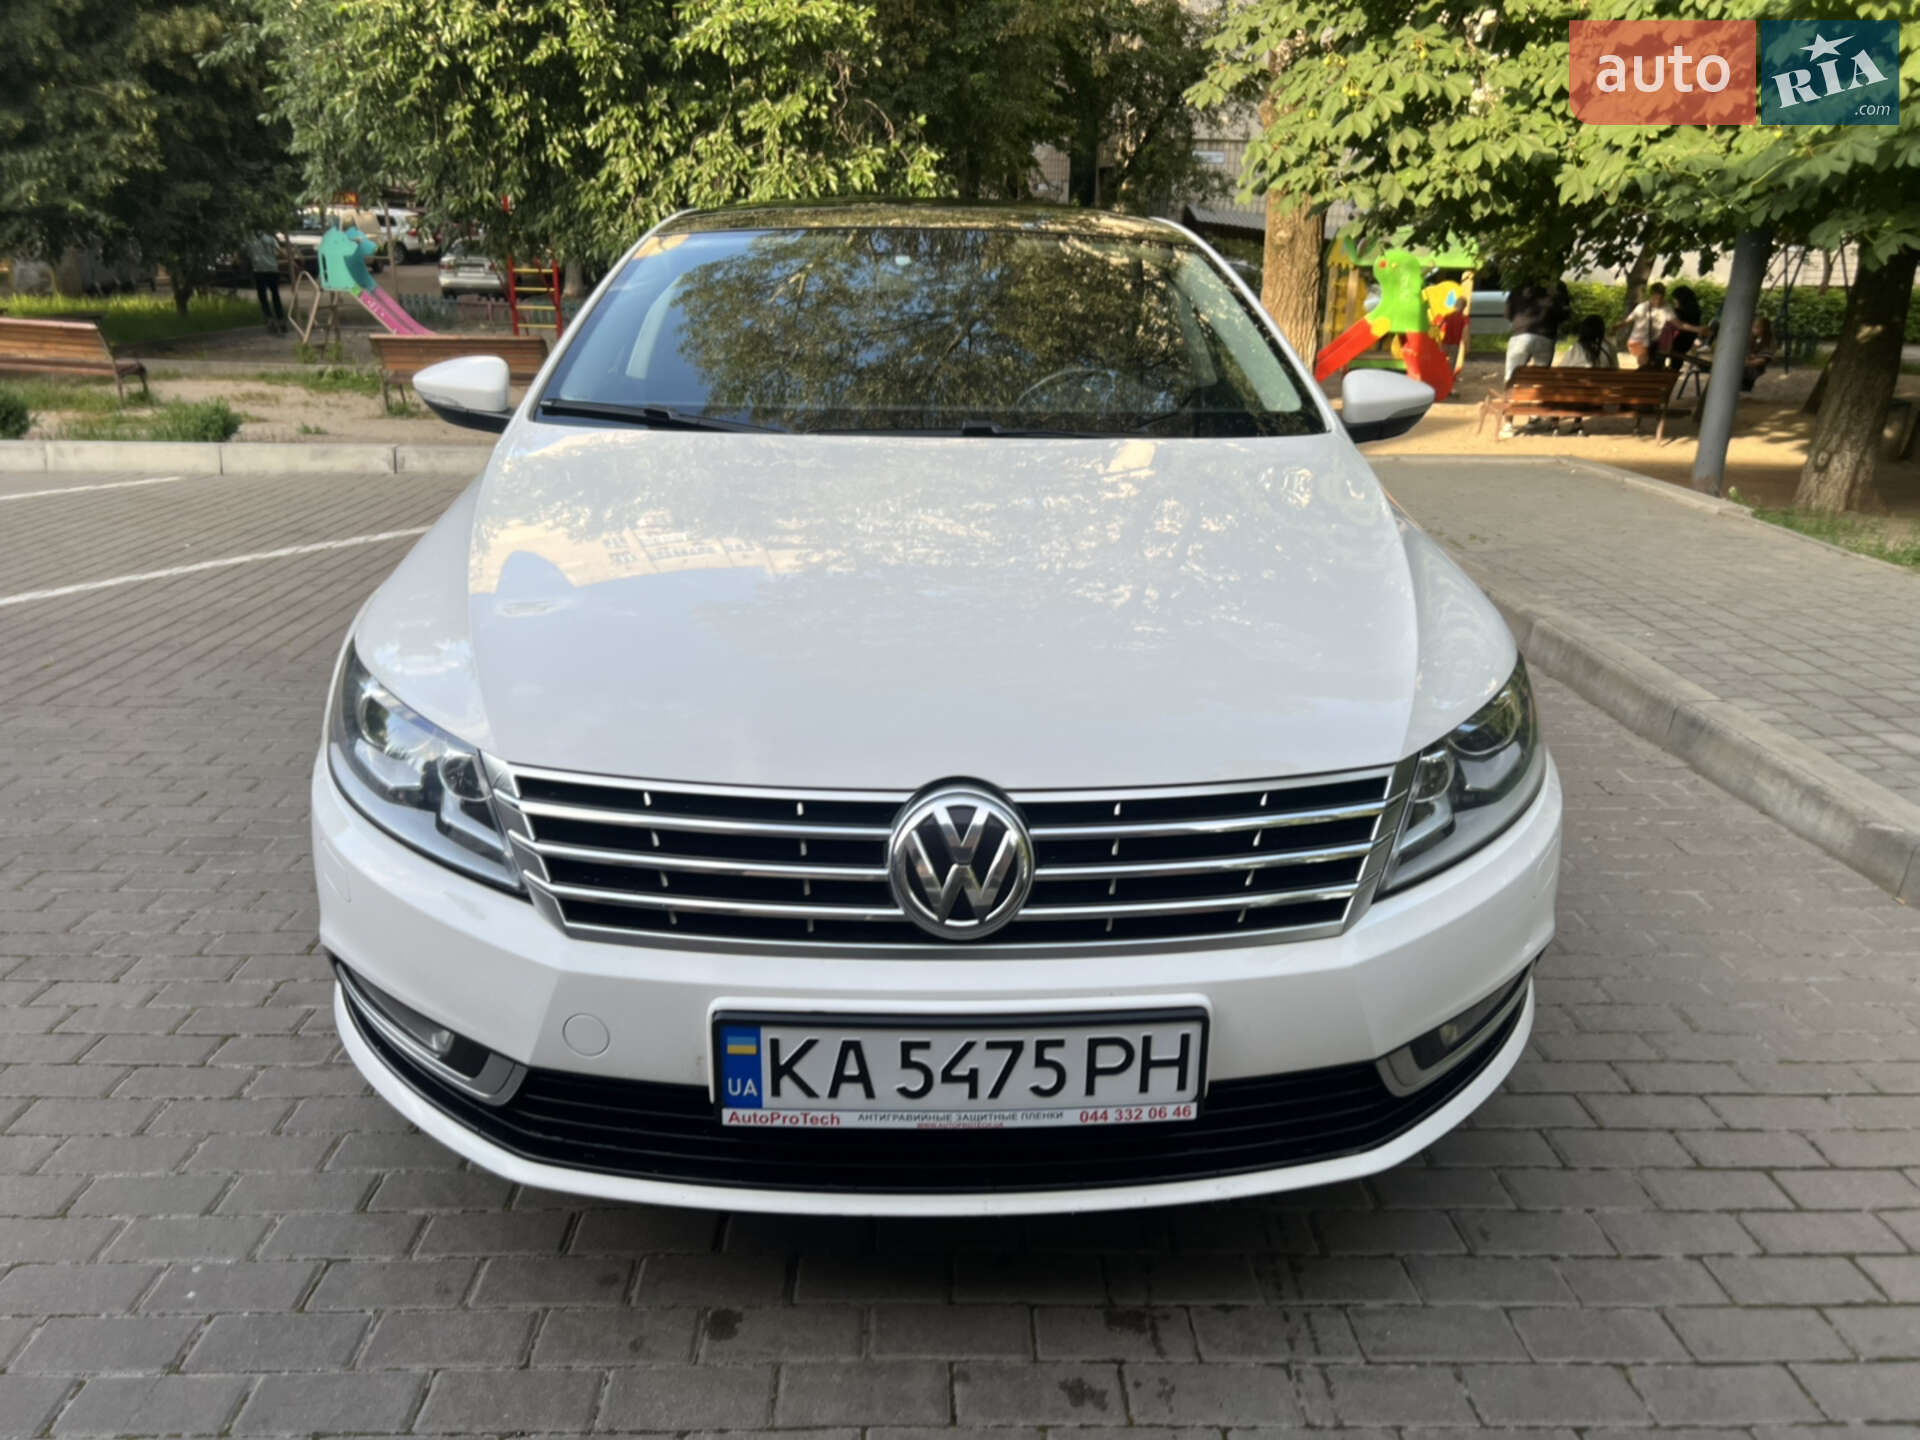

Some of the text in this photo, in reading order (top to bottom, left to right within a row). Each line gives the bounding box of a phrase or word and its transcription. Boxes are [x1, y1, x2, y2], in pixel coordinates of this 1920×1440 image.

[769, 1032, 1192, 1100] KA 5475 PH
[728, 1078, 758, 1097] UA
[728, 1111, 840, 1126] AutoProTech
[1080, 1104, 1192, 1123] 044 332 06 46
